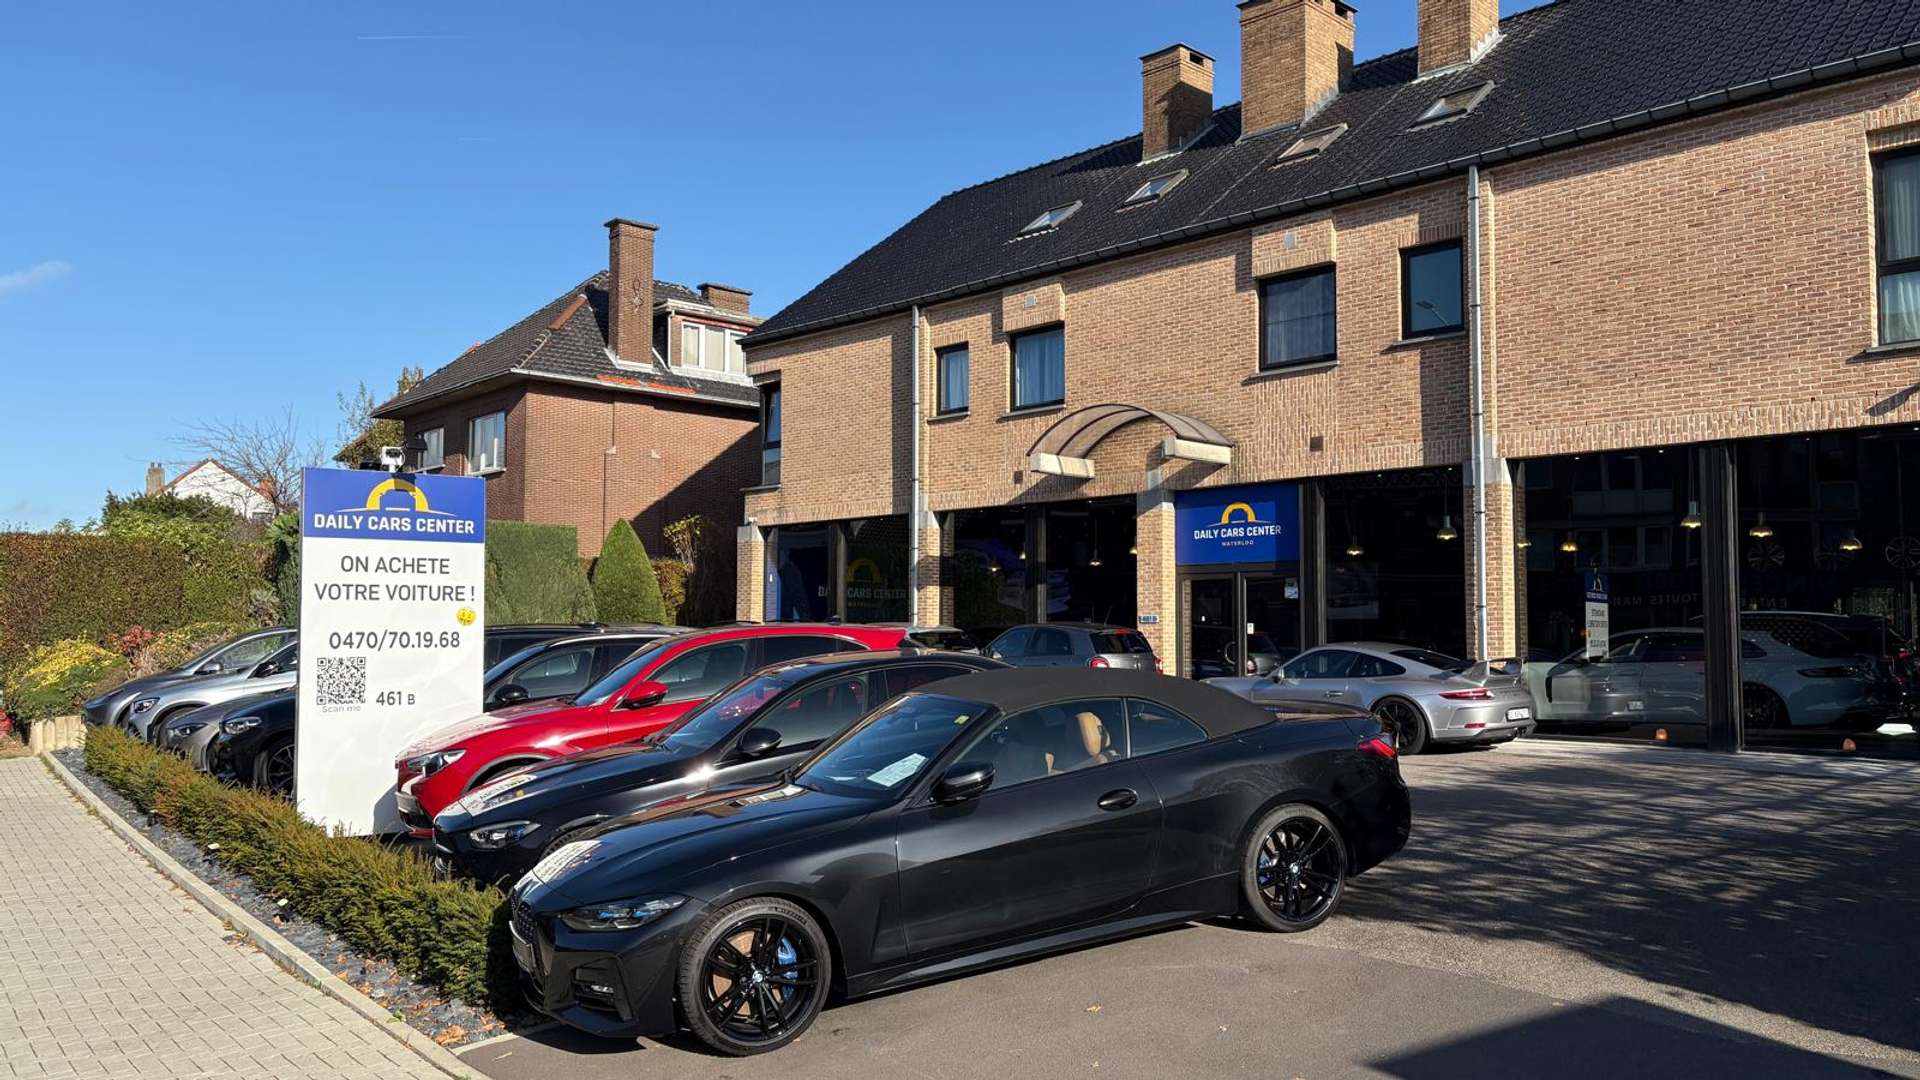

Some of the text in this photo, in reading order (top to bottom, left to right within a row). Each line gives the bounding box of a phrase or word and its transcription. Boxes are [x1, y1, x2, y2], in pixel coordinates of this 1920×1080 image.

[314, 513, 474, 534] DAILY CARS CENTER
[1194, 525, 1282, 539] DAILY CARS CENTER
[340, 555, 450, 574] ON ACHETE
[314, 583, 380, 601] VOTRE
[385, 585, 466, 602] VOITURE
[329, 629, 460, 651] 0470/70.19.68
[376, 691, 415, 706] 461 B
[322, 705, 345, 713] Scan
